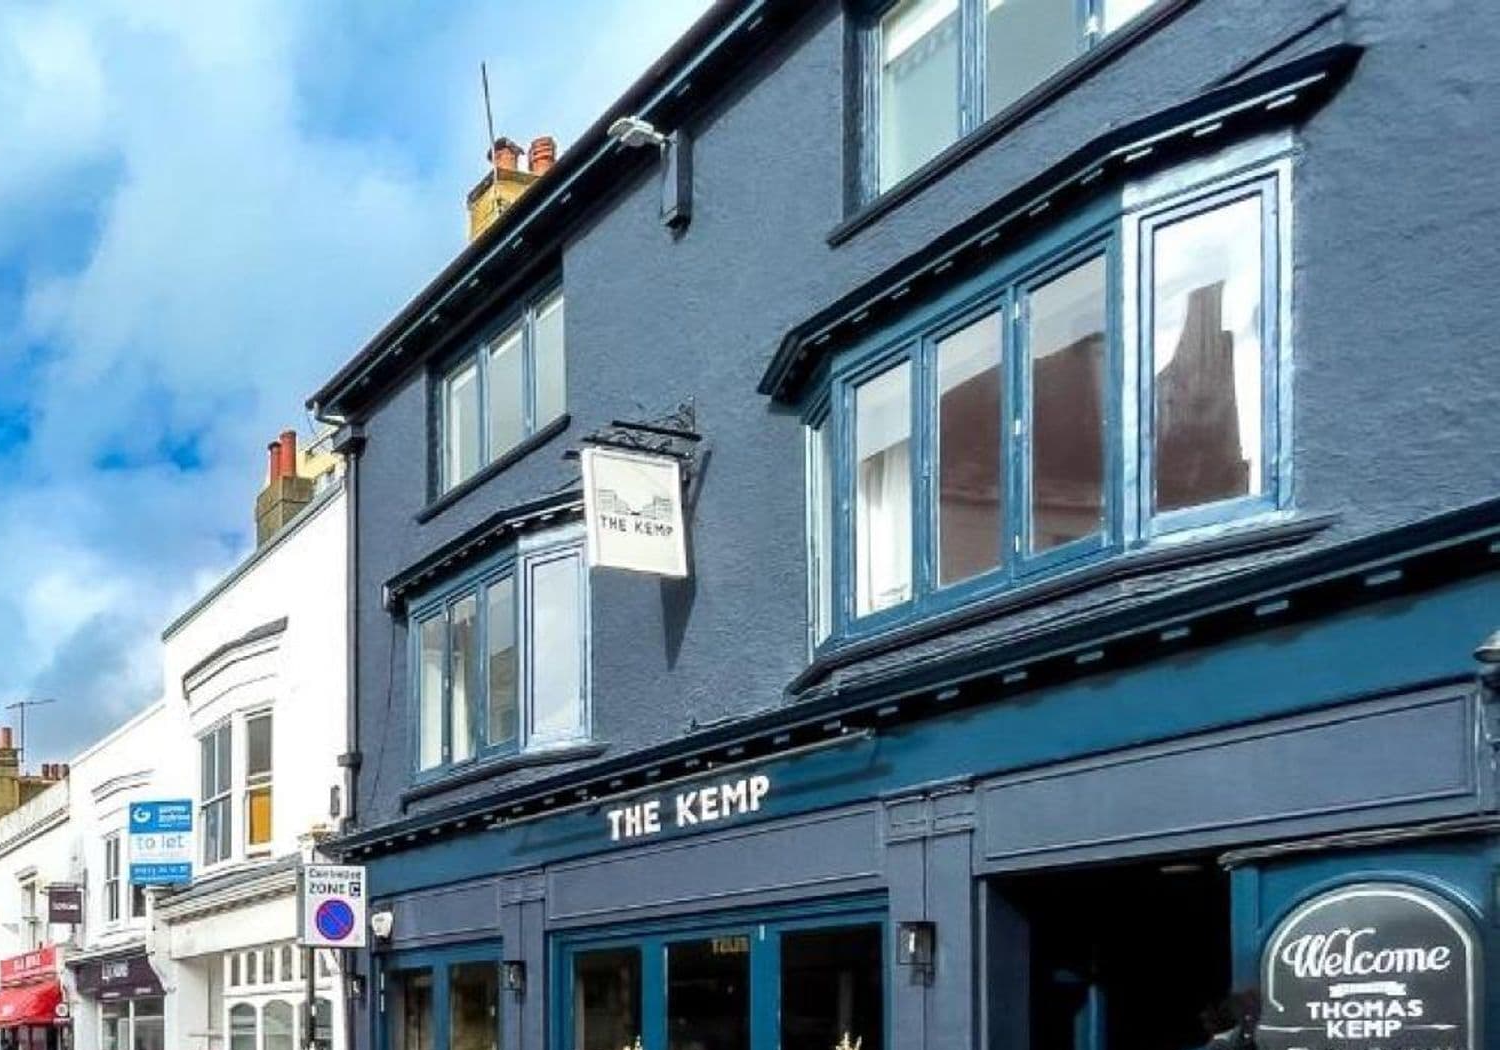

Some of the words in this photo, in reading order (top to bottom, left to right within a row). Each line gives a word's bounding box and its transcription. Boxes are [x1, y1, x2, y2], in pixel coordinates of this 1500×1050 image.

[601, 515, 627, 532] THE
[634, 520, 673, 537] KEMP
[607, 800, 661, 841] THE
[675, 775, 770, 827] KEMP
[138, 837, 156, 849] to
[161, 834, 185, 849] let
[308, 882, 346, 895] ZONE
[1281, 927, 1451, 979] Welcome
[1305, 999, 1424, 1020] THOMAS
[1326, 1019, 1403, 1039] KEMP
